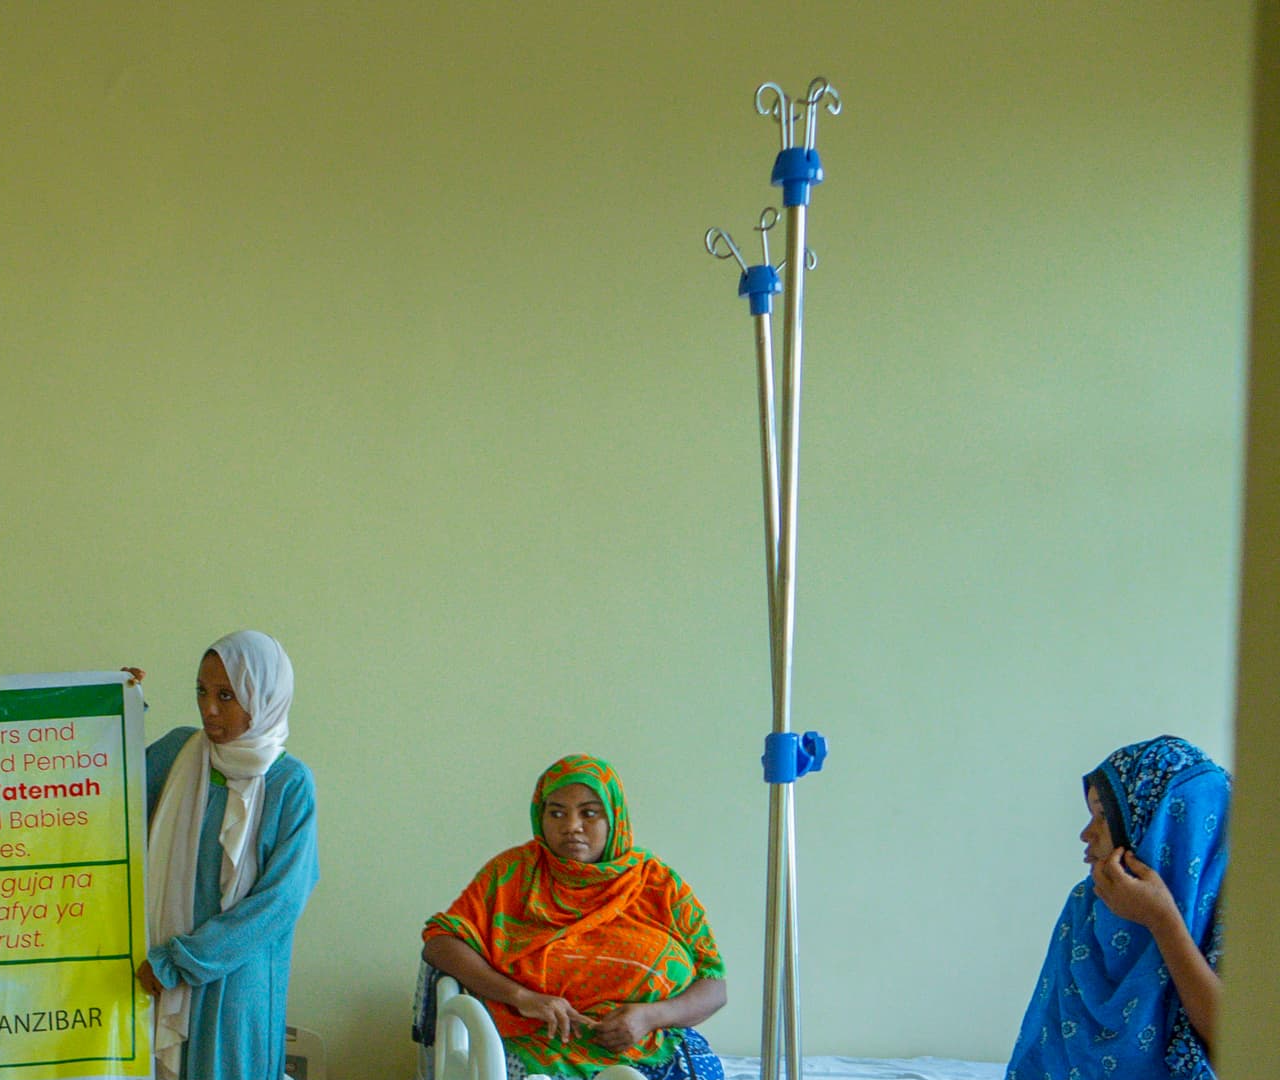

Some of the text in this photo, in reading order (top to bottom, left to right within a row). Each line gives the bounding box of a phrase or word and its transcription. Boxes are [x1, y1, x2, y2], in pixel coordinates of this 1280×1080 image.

[28, 722, 75, 743] and
[23, 750, 108, 771] Pemba
[9, 807, 88, 829] Babies
[61, 872, 93, 890] na
[55, 901, 85, 923] ya
